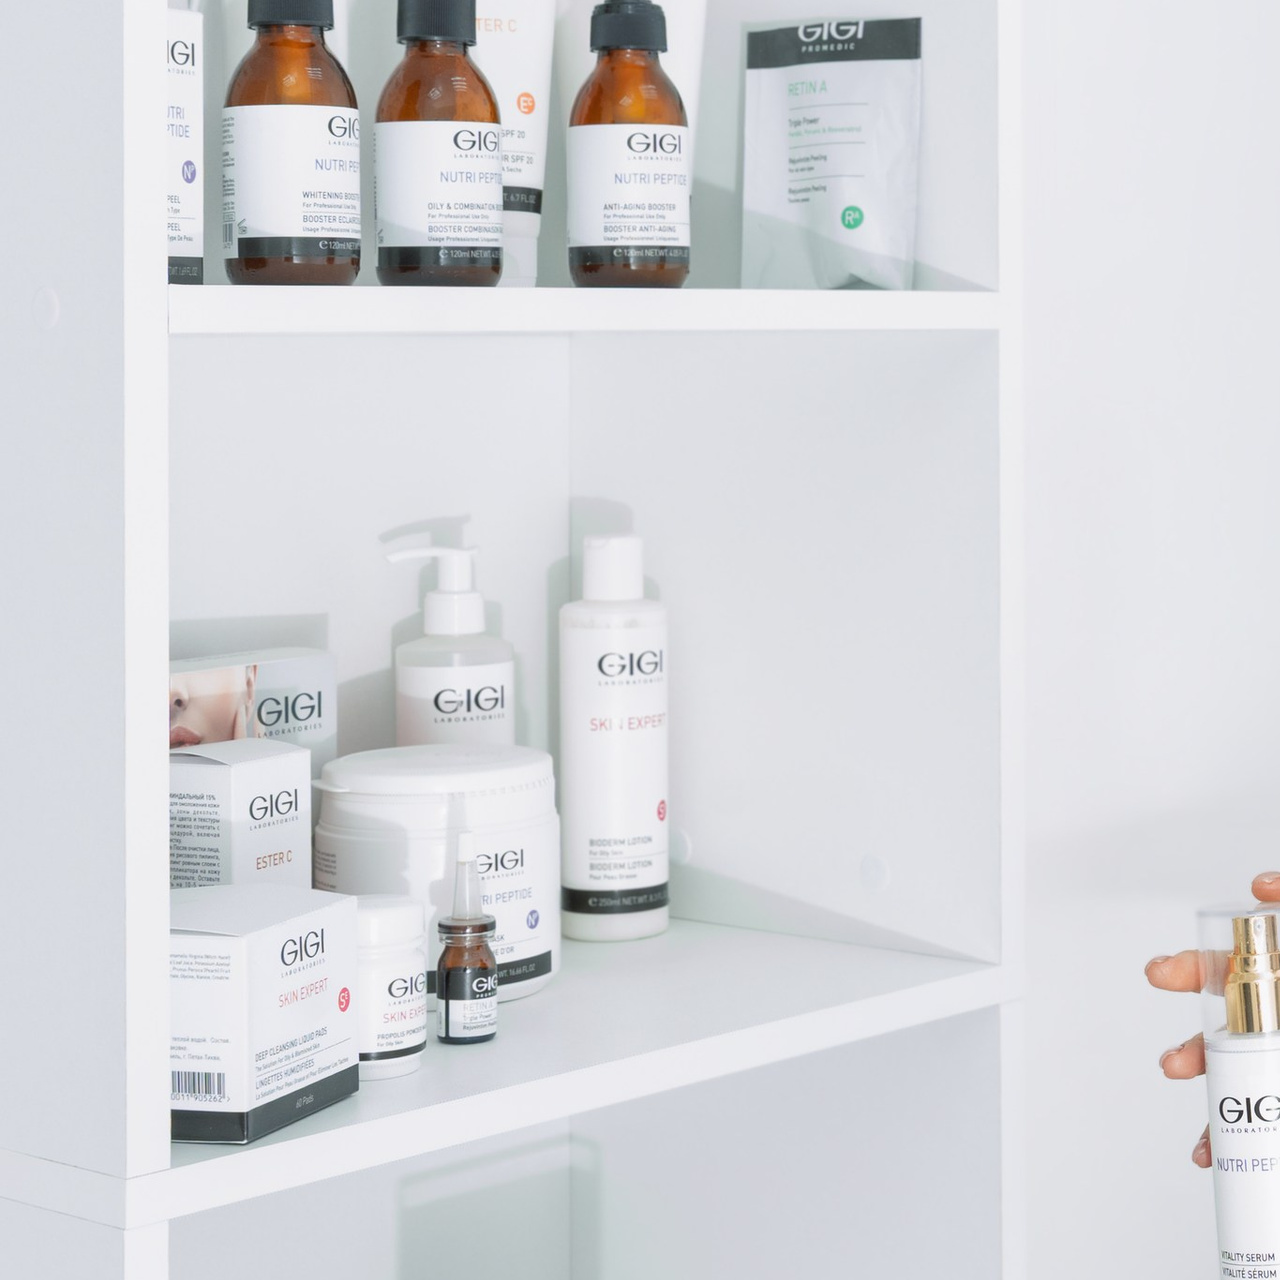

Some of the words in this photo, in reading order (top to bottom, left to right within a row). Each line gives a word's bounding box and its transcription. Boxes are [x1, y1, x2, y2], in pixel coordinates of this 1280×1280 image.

[475, 17, 503, 32] TER
[508, 18, 518, 32] C
[797, 20, 865, 43] GIGI
[167, 39, 195, 67] IGI
[801, 42, 856, 54] PROMEDIC
[787, 80, 816, 97] RETIN
[820, 80, 828, 94] A
[167, 123, 190, 138] TIDE
[328, 115, 360, 140] GIG
[501, 129, 515, 138] SPF
[517, 130, 526, 139] 20
[452, 129, 500, 153] GIGI
[627, 132, 681, 154] GIGI
[315, 158, 347, 172] NUTRI
[511, 154, 525, 164] SPF
[527, 155, 534, 165] 20
[440, 170, 476, 184] NUTRI
[614, 172, 651, 185] NUTRI
[653, 173, 687, 187] PEPTIDE
[302, 191, 343, 201] WHITENING
[313, 202, 343, 210] Professional
[428, 202, 444, 211] OILY
[446, 202, 452, 211] &
[454, 203, 495, 211] COMBINATION
[603, 203, 646, 212] ANTI-AGING
[647, 203, 676, 212] BOOSTER
[303, 214, 337, 224] BOOSTER
[303, 226, 319, 234] Usage
[428, 225, 462, 234] BOOSTER
[603, 224, 637, 233] BOOSTER
[639, 225, 676, 233] ANTI-AGING
[428, 236, 445, 244] Usage
[603, 235, 619, 243] Usage
[450, 249, 470, 259] 120ml
[624, 248, 644, 258] 120ml
[597, 649, 663, 677] GIGI
[433, 685, 504, 714] GIGI
[257, 691, 322, 727] GIGI
[434, 713, 505, 724] LABORATORIES
[257, 723, 322, 739] LABORATORIES
[249, 788, 298, 821] GIGI
[249, 815, 299, 831] LABORATORIES
[589, 838, 626, 848] BIODERM
[627, 836, 653, 846] LOTION
[175, 852, 198, 860] рисового
[256, 851, 284, 871] ESTER
[286, 849, 293, 863] C
[589, 862, 626, 872] BIODERM
[627, 860, 653, 870] LOTION
[495, 887, 533, 904] PEPTIDE
[281, 927, 324, 967] GIGI
[281, 957, 326, 979] LABORATORIES
[388, 972, 426, 999] GIG
[472, 974, 497, 993] GIG
[278, 988, 299, 1008] SKIN
[300, 977, 328, 1001] EXPERT
[463, 1002, 485, 1013] RETIN
[383, 1011, 407, 1024] SKIN
[377, 1031, 406, 1040] PROPOLIS
[255, 1049, 269, 1062] DEEP
[269, 1038, 298, 1057] CLEANSING
[299, 1031, 315, 1046] LIQUID
[315, 1026, 328, 1038] PADS
[256, 1071, 283, 1090] LINGETTES
[193, 1094, 223, 1103] 905262
[303, 1093, 315, 1106] Pads
[1217, 1157, 1248, 1172] NUTRI
[1220, 1251, 1244, 1262] VITALITY
[1246, 1253, 1276, 1262] SERUM
[1222, 1267, 1246, 1279] VITALITÉ
[1247, 1267, 1278, 1279] SÉRUM
